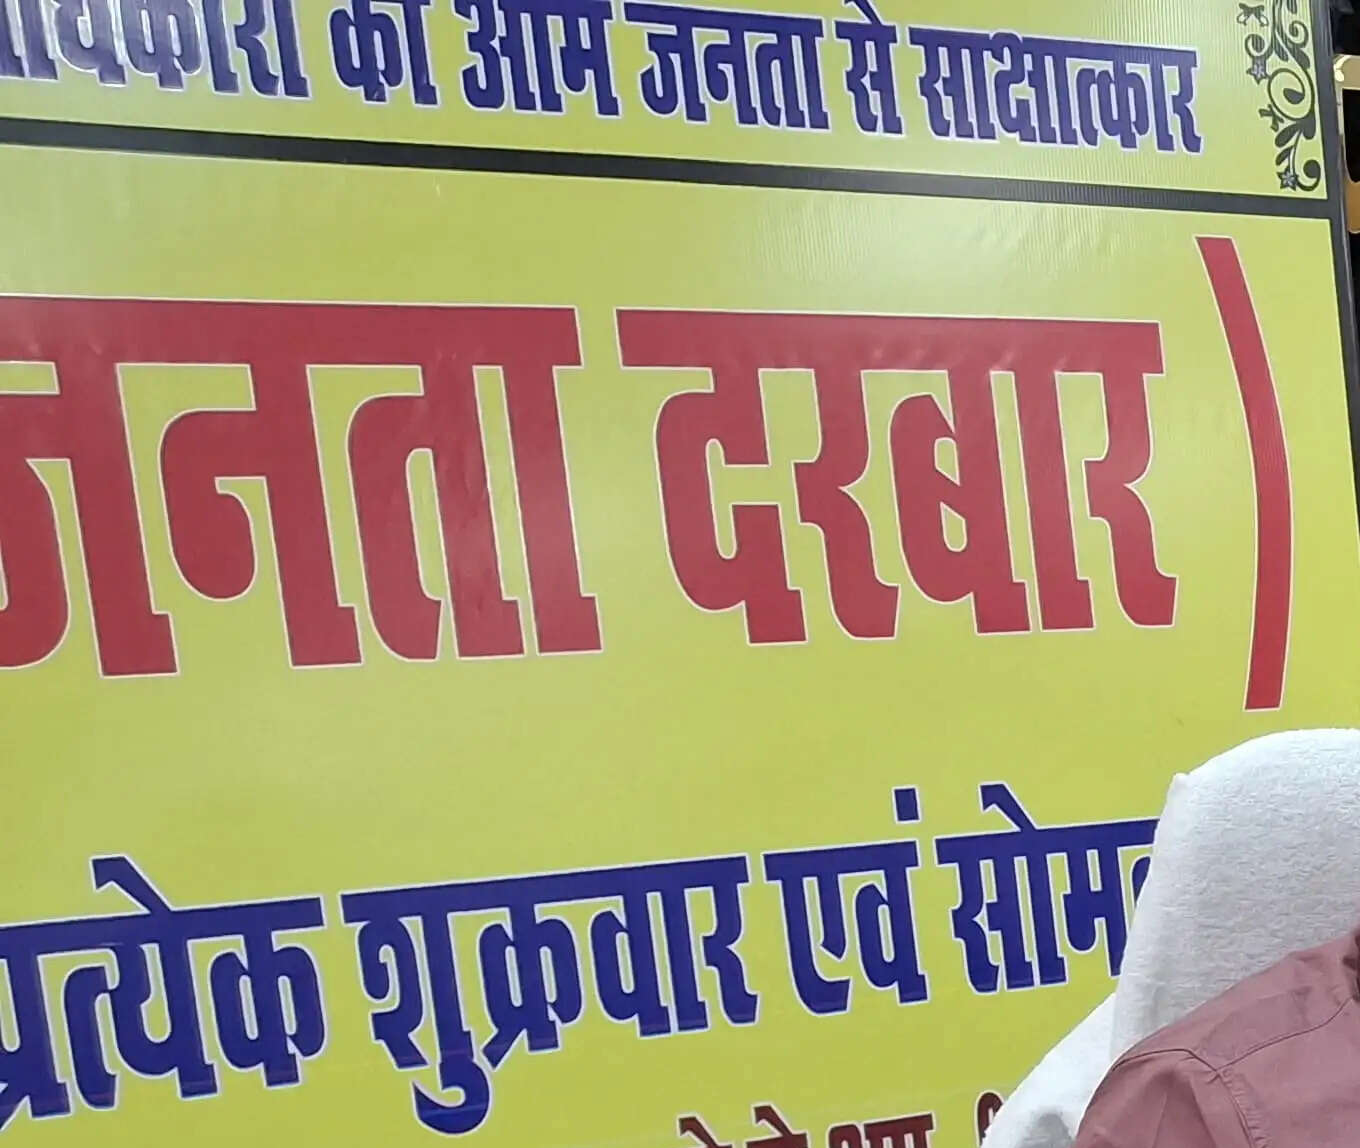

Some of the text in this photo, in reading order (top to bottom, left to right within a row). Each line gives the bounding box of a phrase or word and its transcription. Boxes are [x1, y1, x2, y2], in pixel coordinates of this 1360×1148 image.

[456, 0, 621, 116] आम
[623, 2, 830, 130] जनता
[834, 0, 902, 135] से
[907, 26, 1202, 154] साक्षात्कार
[615, 306, 1179, 648] दरबार
[339, 853, 760, 1136] शुक्रवार
[762, 786, 929, 1016] एवं
[934, 782, 1160, 993] सोम
